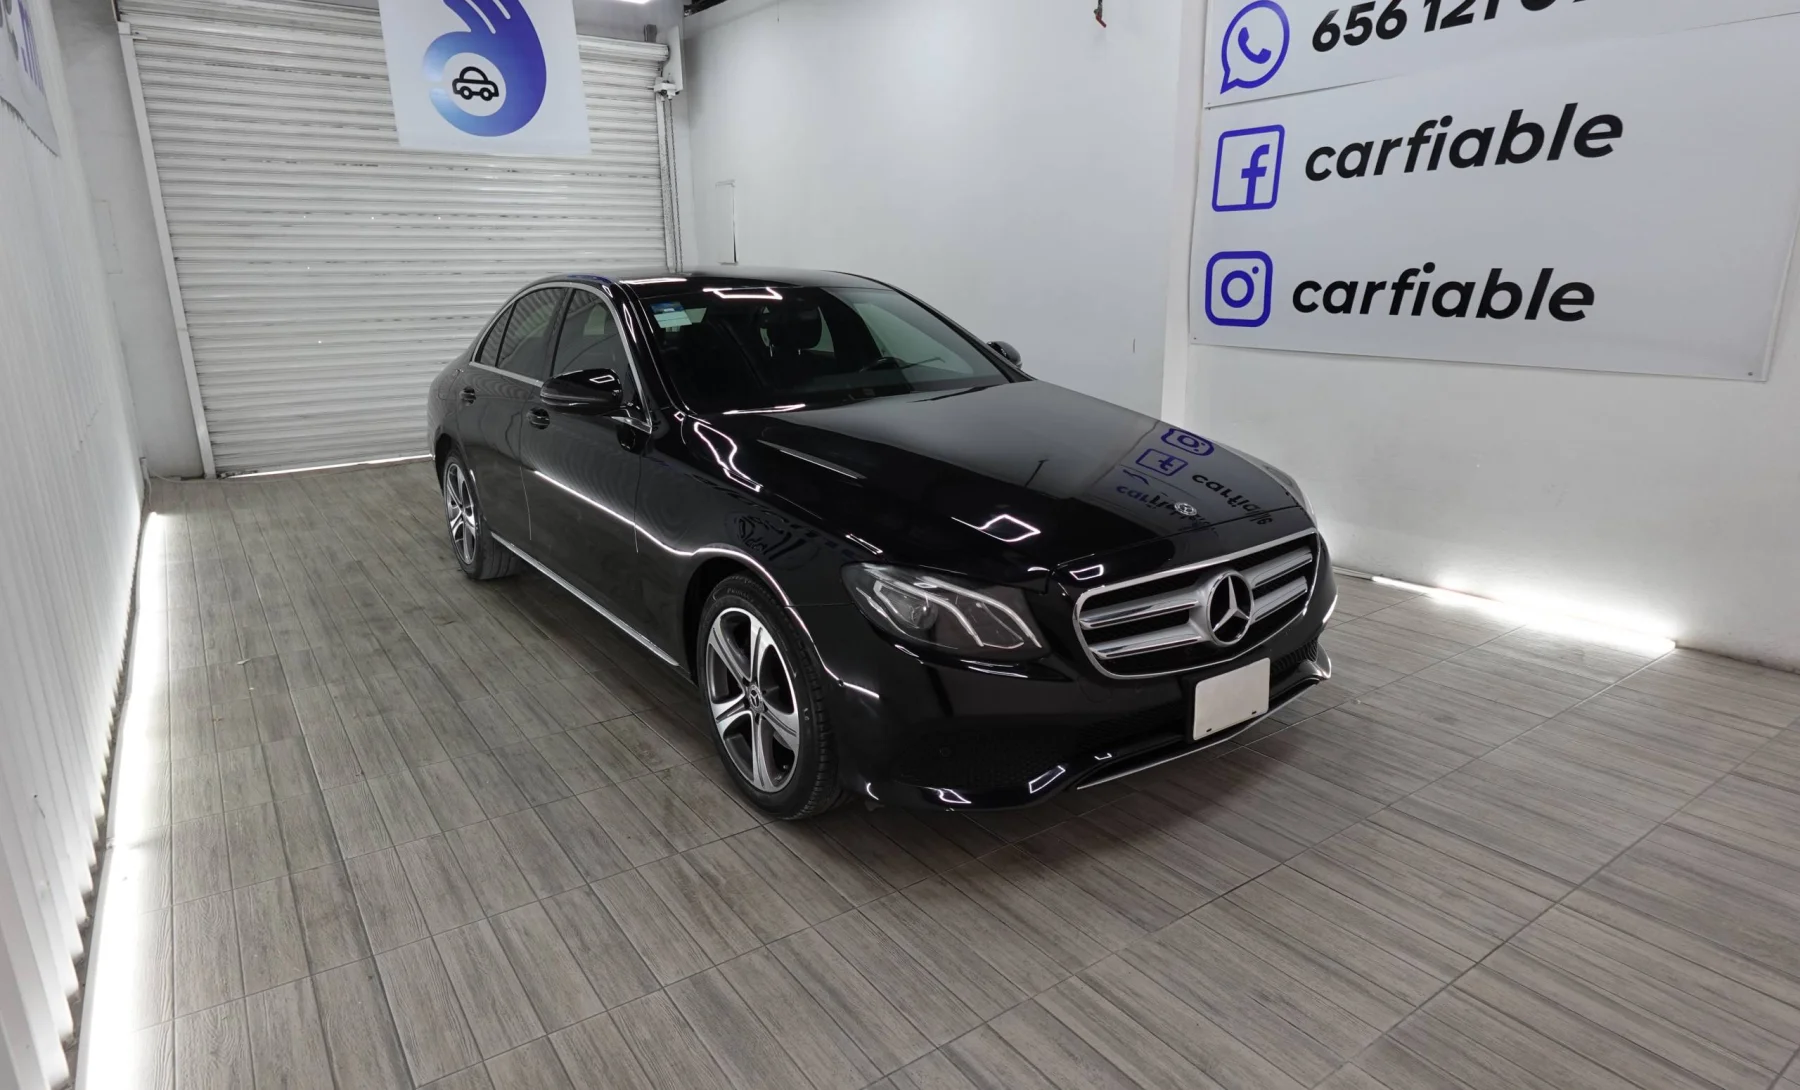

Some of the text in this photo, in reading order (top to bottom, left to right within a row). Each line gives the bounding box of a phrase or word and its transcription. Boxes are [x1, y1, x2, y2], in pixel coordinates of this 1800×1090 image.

[1312, 0, 1408, 53] 656
[1305, 102, 1623, 182] carfiable
[1292, 261, 1595, 323] carfiable
